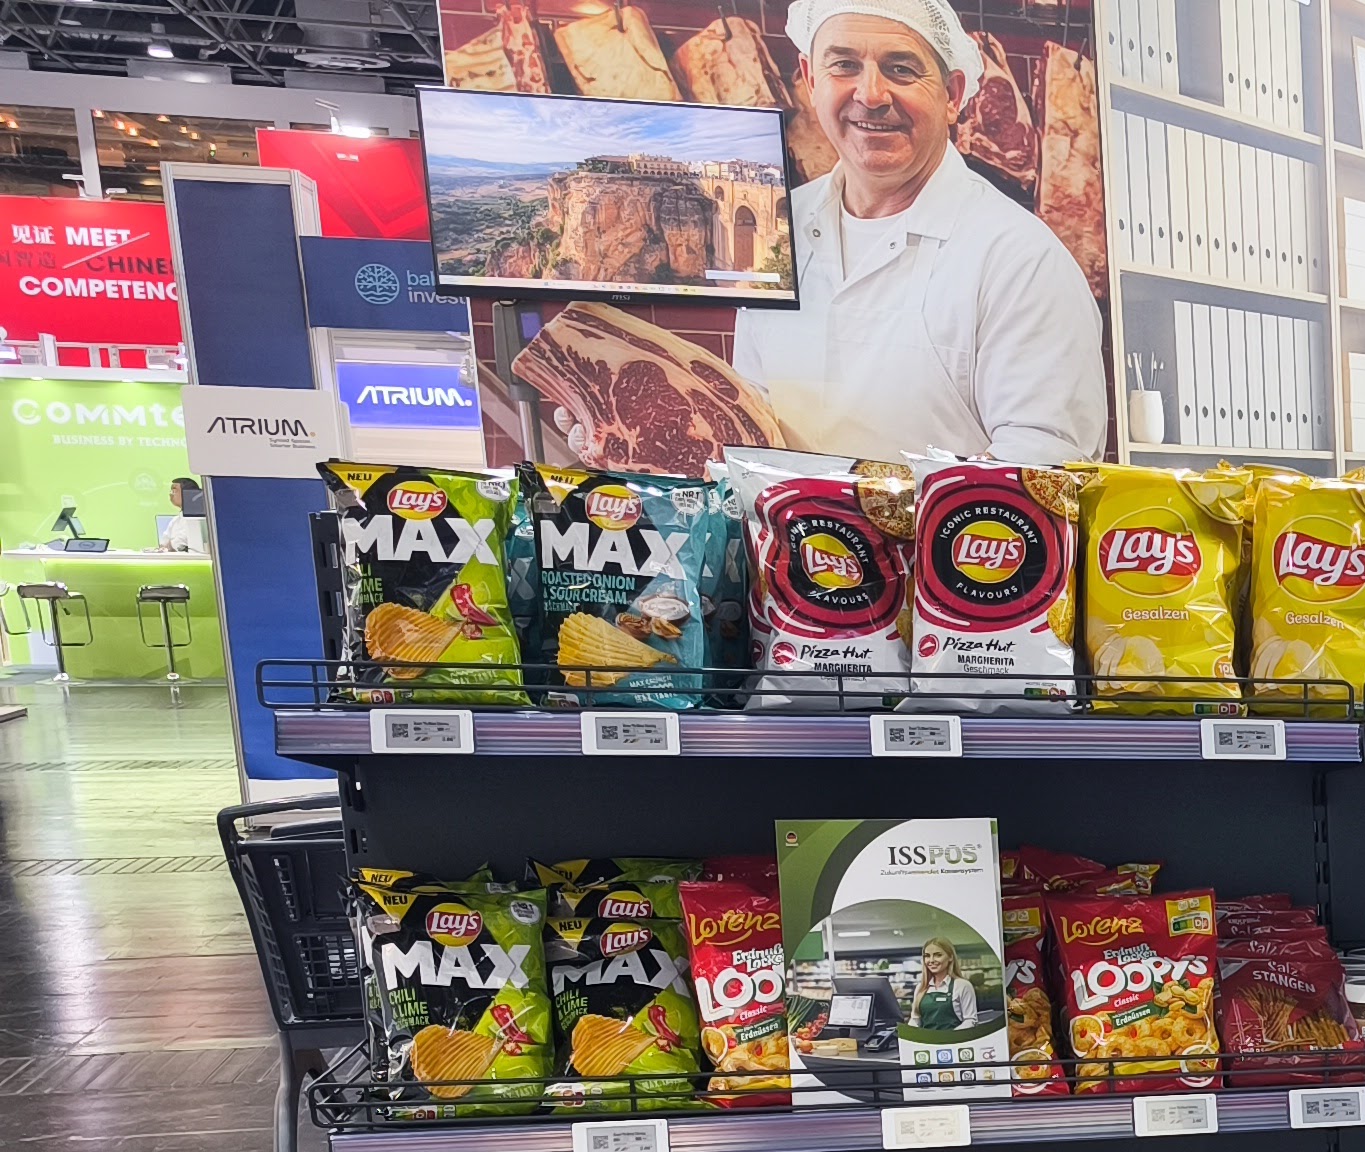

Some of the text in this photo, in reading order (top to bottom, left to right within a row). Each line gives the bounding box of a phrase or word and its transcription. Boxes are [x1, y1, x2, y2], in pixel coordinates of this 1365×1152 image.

[12, 224, 131, 247] 见证 MEET
[119, 435, 133, 446] BY
[391, 489, 446, 513] Lay's
[589, 491, 639, 521] Lay's
[974, 506, 1039, 546] RESTAURANT
[342, 514, 499, 567] MAX
[540, 519, 689, 581] MAX
[958, 535, 1022, 570] Lay's
[1105, 529, 1195, 577] Lay's
[593, 574, 636, 591] ONION
[955, 582, 1019, 600] FLAVOURS
[550, 585, 581, 602] SOUR
[1121, 605, 1190, 622] Gesalzen
[1285, 611, 1346, 631] Gesalzen
[800, 644, 873, 660] Pizza Hut
[943, 636, 1015, 653] Pizza Hut
[957, 653, 1015, 667] MARGHERITA
[370, 873, 393, 884] NEU
[383, 894, 408, 906] NEU
[429, 911, 481, 938] Lay's
[558, 920, 583, 931] NEU
[689, 910, 781, 946] Lorenz
[1060, 916, 1145, 944] Lorenz
[603, 928, 649, 955] Lay's
[381, 939, 532, 992] MAX
[552, 947, 691, 998] MAX
[1267, 961, 1299, 977] Salz
[1252, 970, 1317, 994] STANGEN
[388, 988, 418, 1006] CHILI
[555, 988, 580, 1007] CHILI
[564, 996, 589, 1015] LIME
[400, 1001, 429, 1017] LIME
